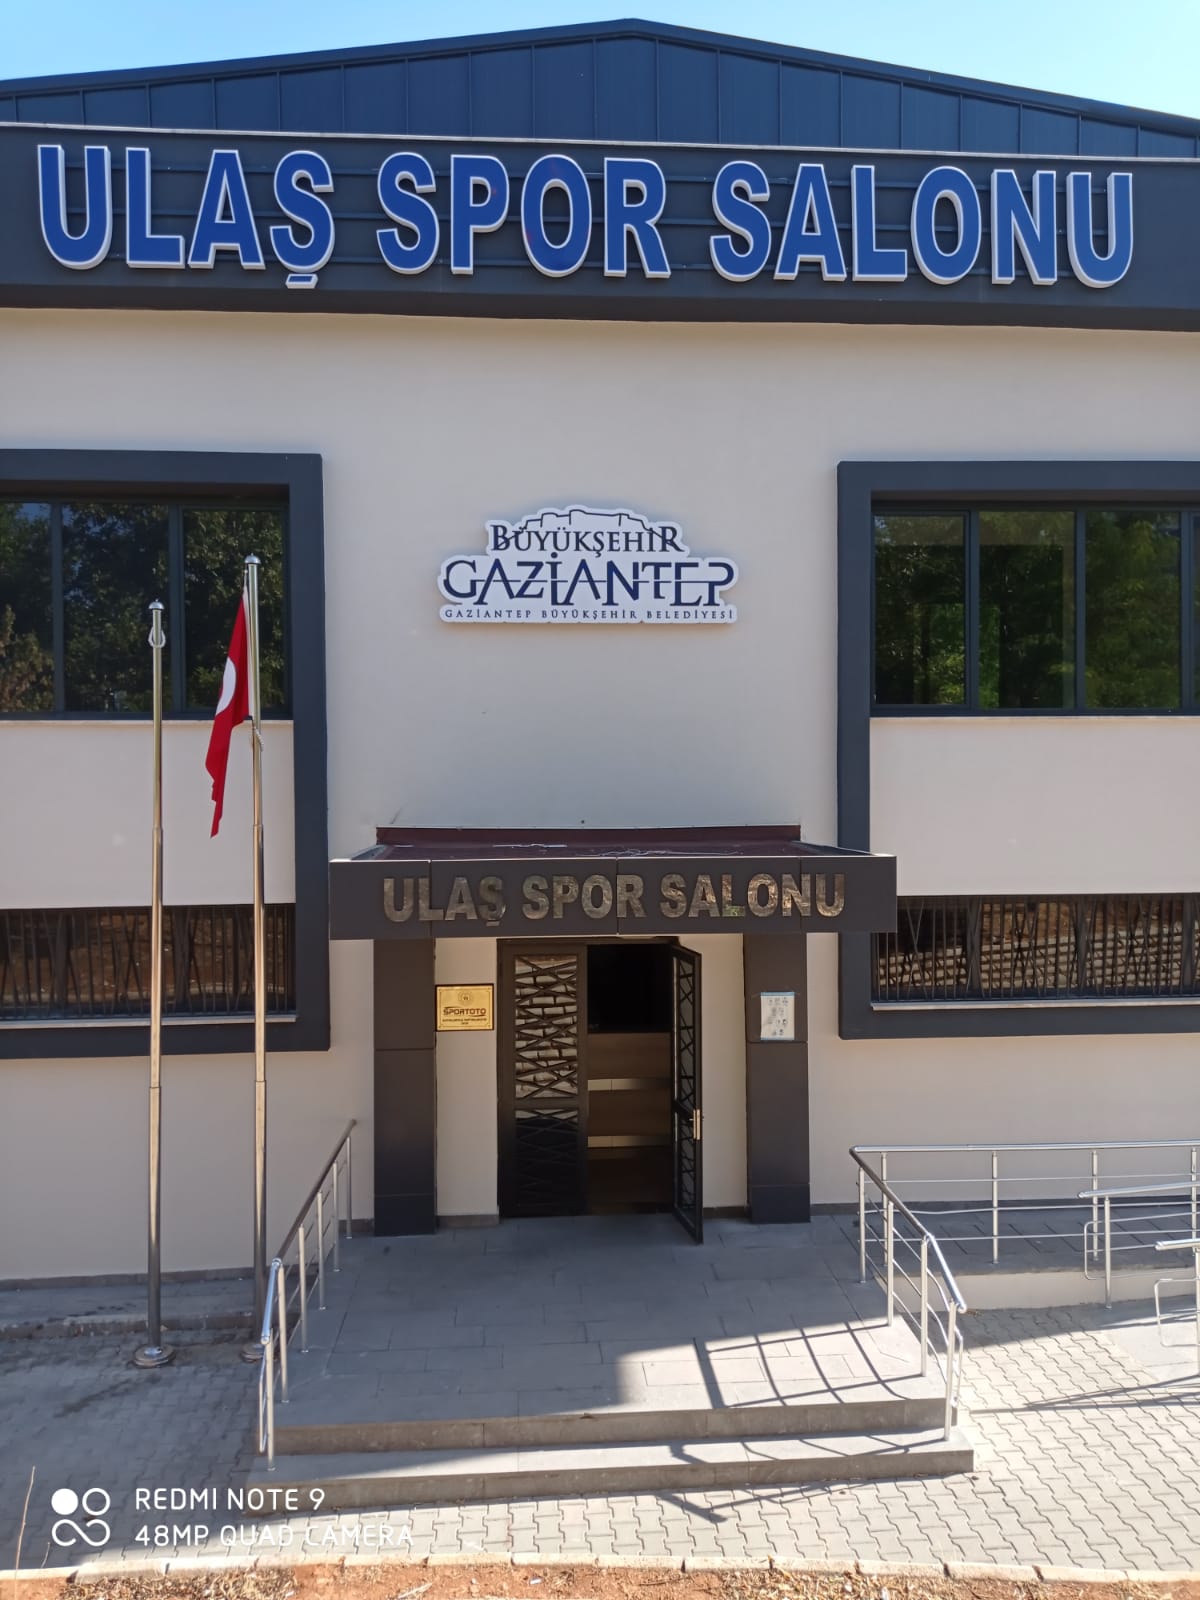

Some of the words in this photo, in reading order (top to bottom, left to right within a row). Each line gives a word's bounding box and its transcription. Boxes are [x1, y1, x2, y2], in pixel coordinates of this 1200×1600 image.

[37, 143, 335, 289] ULAŞ
[376, 151, 671, 279] SPOR
[709, 160, 1134, 289] SALONU
[489, 523, 686, 557] BÜYÜKŞEHİR
[442, 551, 735, 607] GAZİANTEP
[444, 608, 532, 619] GAZİANTEP
[541, 608, 638, 621] BÜYÜKŞEHİR
[646, 608, 734, 620] BELEDİYESİ
[382, 876, 506, 927] ULAŞ
[521, 873, 647, 919] SPOR
[659, 872, 845, 918] SALONU
